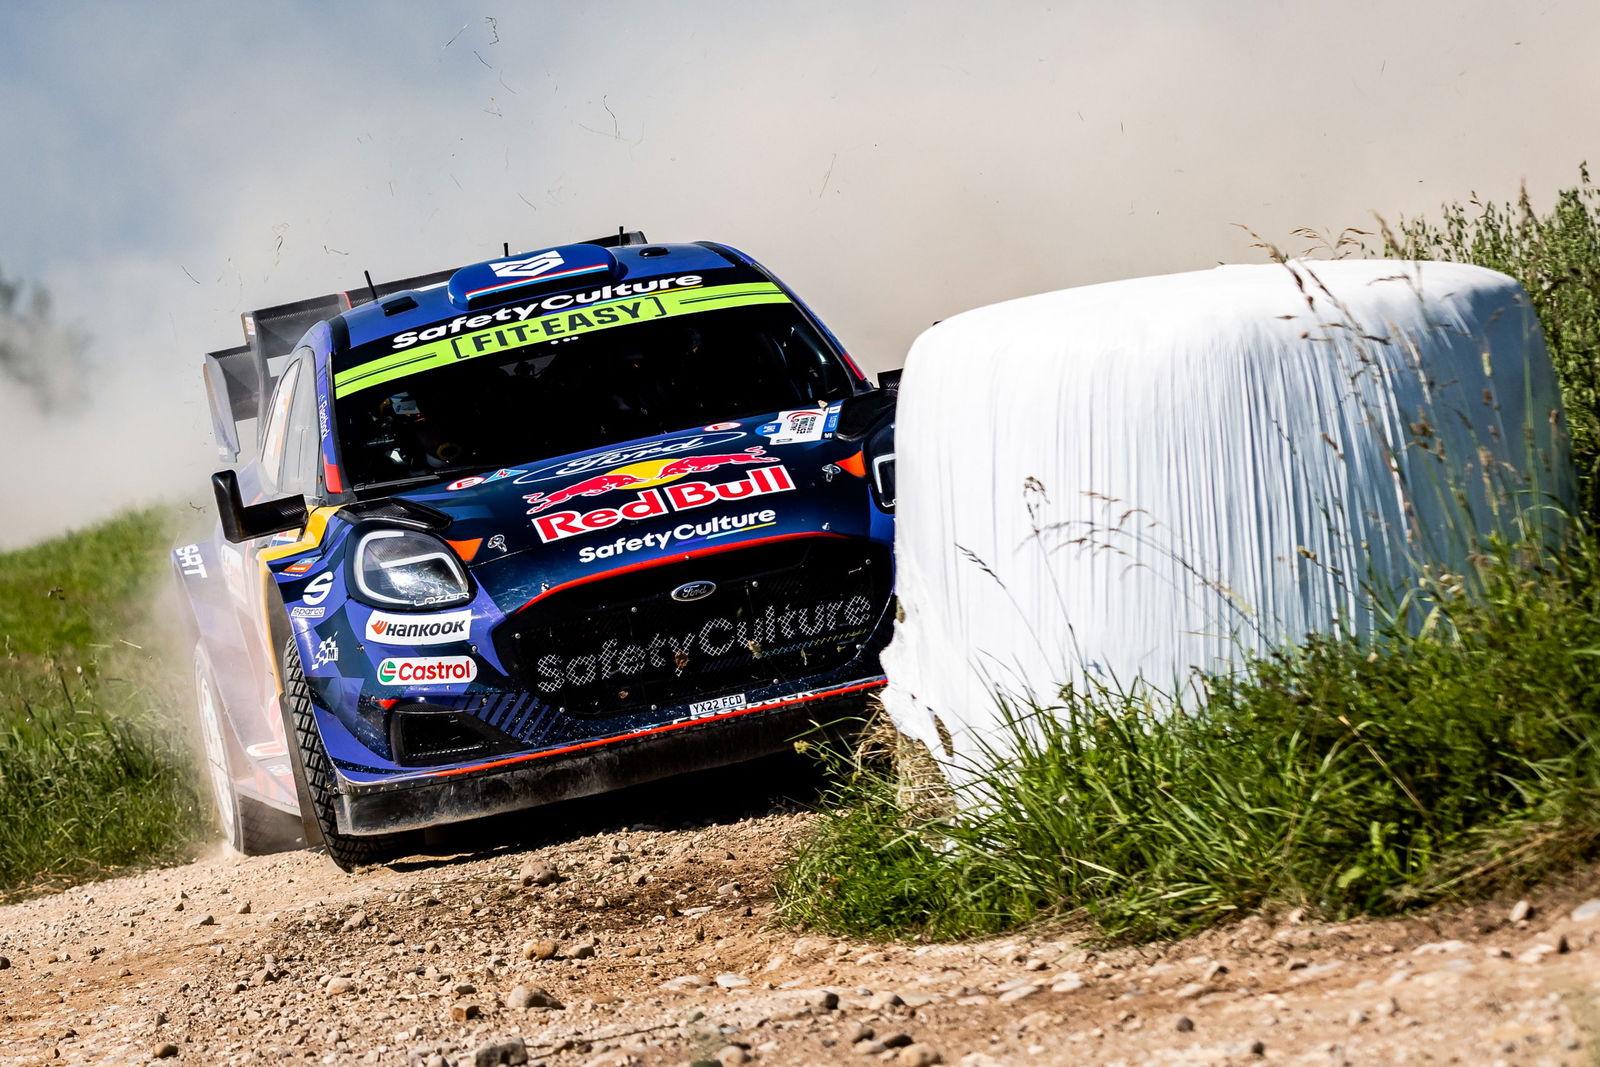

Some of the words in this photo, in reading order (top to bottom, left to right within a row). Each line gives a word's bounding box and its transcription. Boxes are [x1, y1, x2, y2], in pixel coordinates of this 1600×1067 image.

[392, 275, 703, 350] SafetyCulture
[556, 437, 703, 475] Ford
[531, 488, 669, 544] Red
[663, 464, 796, 512] Bull
[579, 509, 776, 563] SafetyCulture
[682, 584, 707, 598] Ford
[293, 607, 324, 617] sparco
[537, 595, 871, 693] SafetyCulture
[399, 660, 471, 681] Castrol
[692, 701, 719, 714] YX22
[722, 695, 742, 707] FCD
